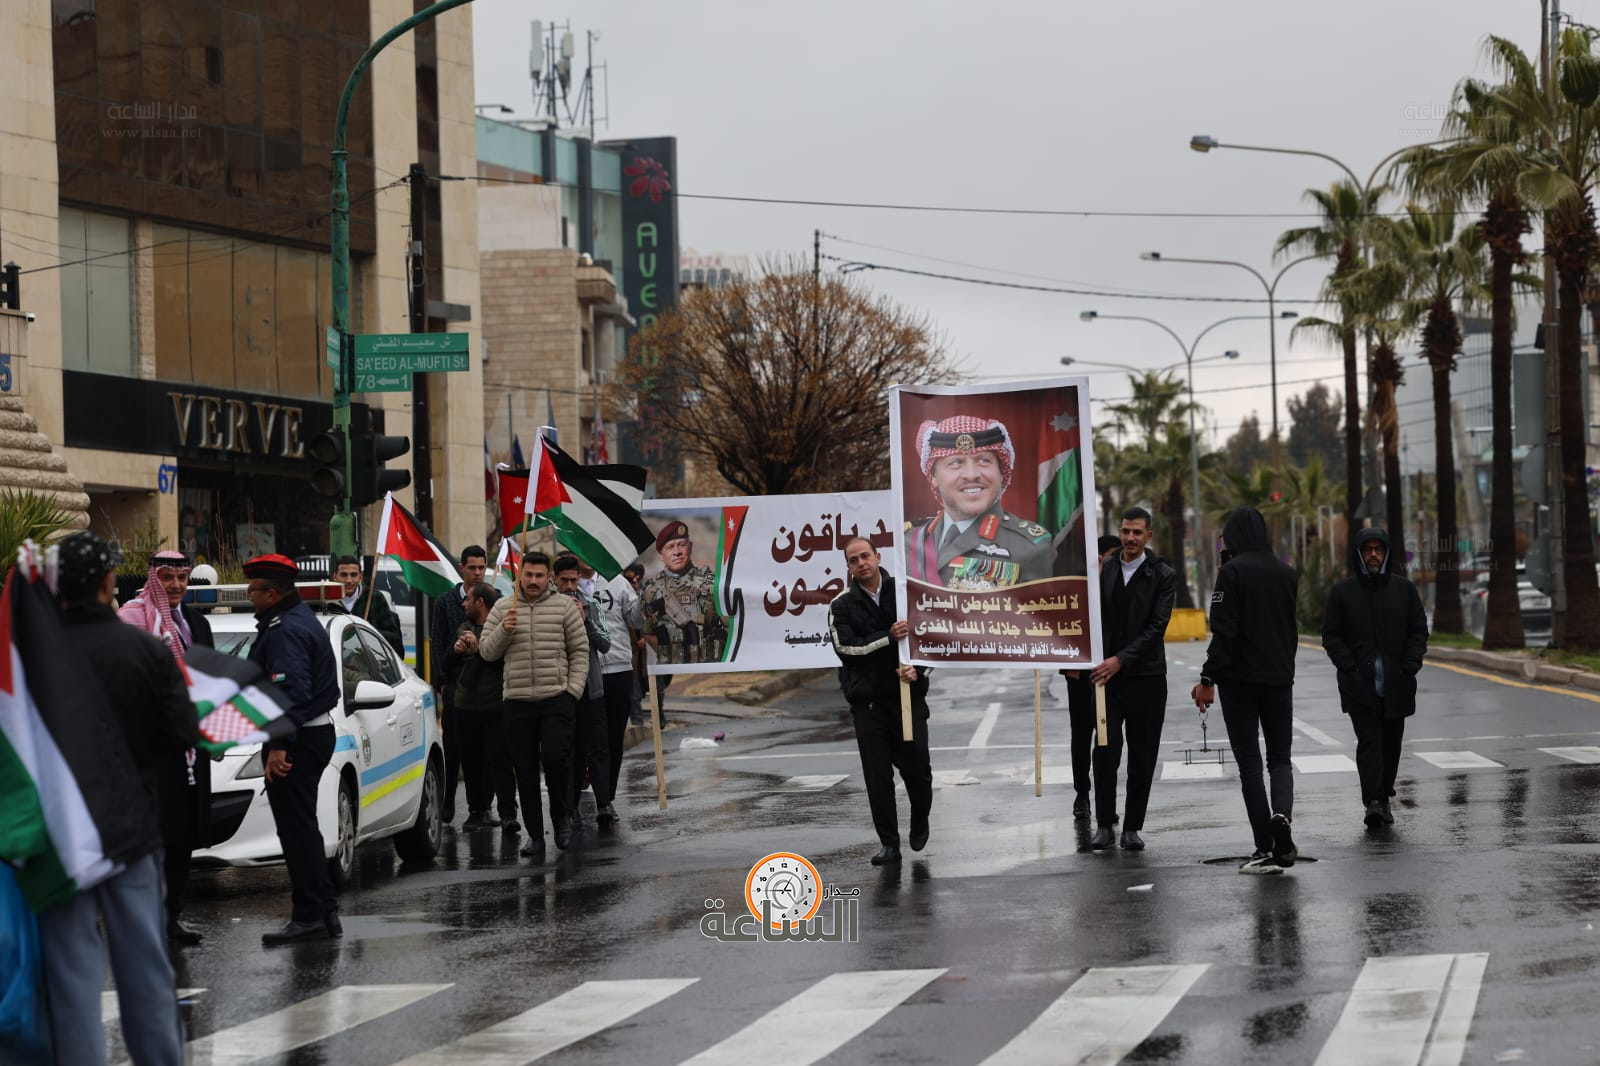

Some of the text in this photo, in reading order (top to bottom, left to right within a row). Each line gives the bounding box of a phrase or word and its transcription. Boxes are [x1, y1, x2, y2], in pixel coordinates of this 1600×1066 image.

[372, 336, 401, 352] المفتي
[357, 357, 397, 370] SA'EED
[399, 355, 450, 370] AL-MUFTI
[356, 374, 408, 389] 78 1
[167, 392, 305, 458] VERVE
[158, 463, 178, 494] 67
[916, 593, 1079, 615] لا للتهجير لا للوطن البديل
[784, 629, 832, 648] وجستية
[914, 619, 1083, 639] كلنا خلف جلالة الملك المفدى
[919, 640, 1080, 659] مؤسسة الآفاق الجديدة للخدمات اللوجستية
